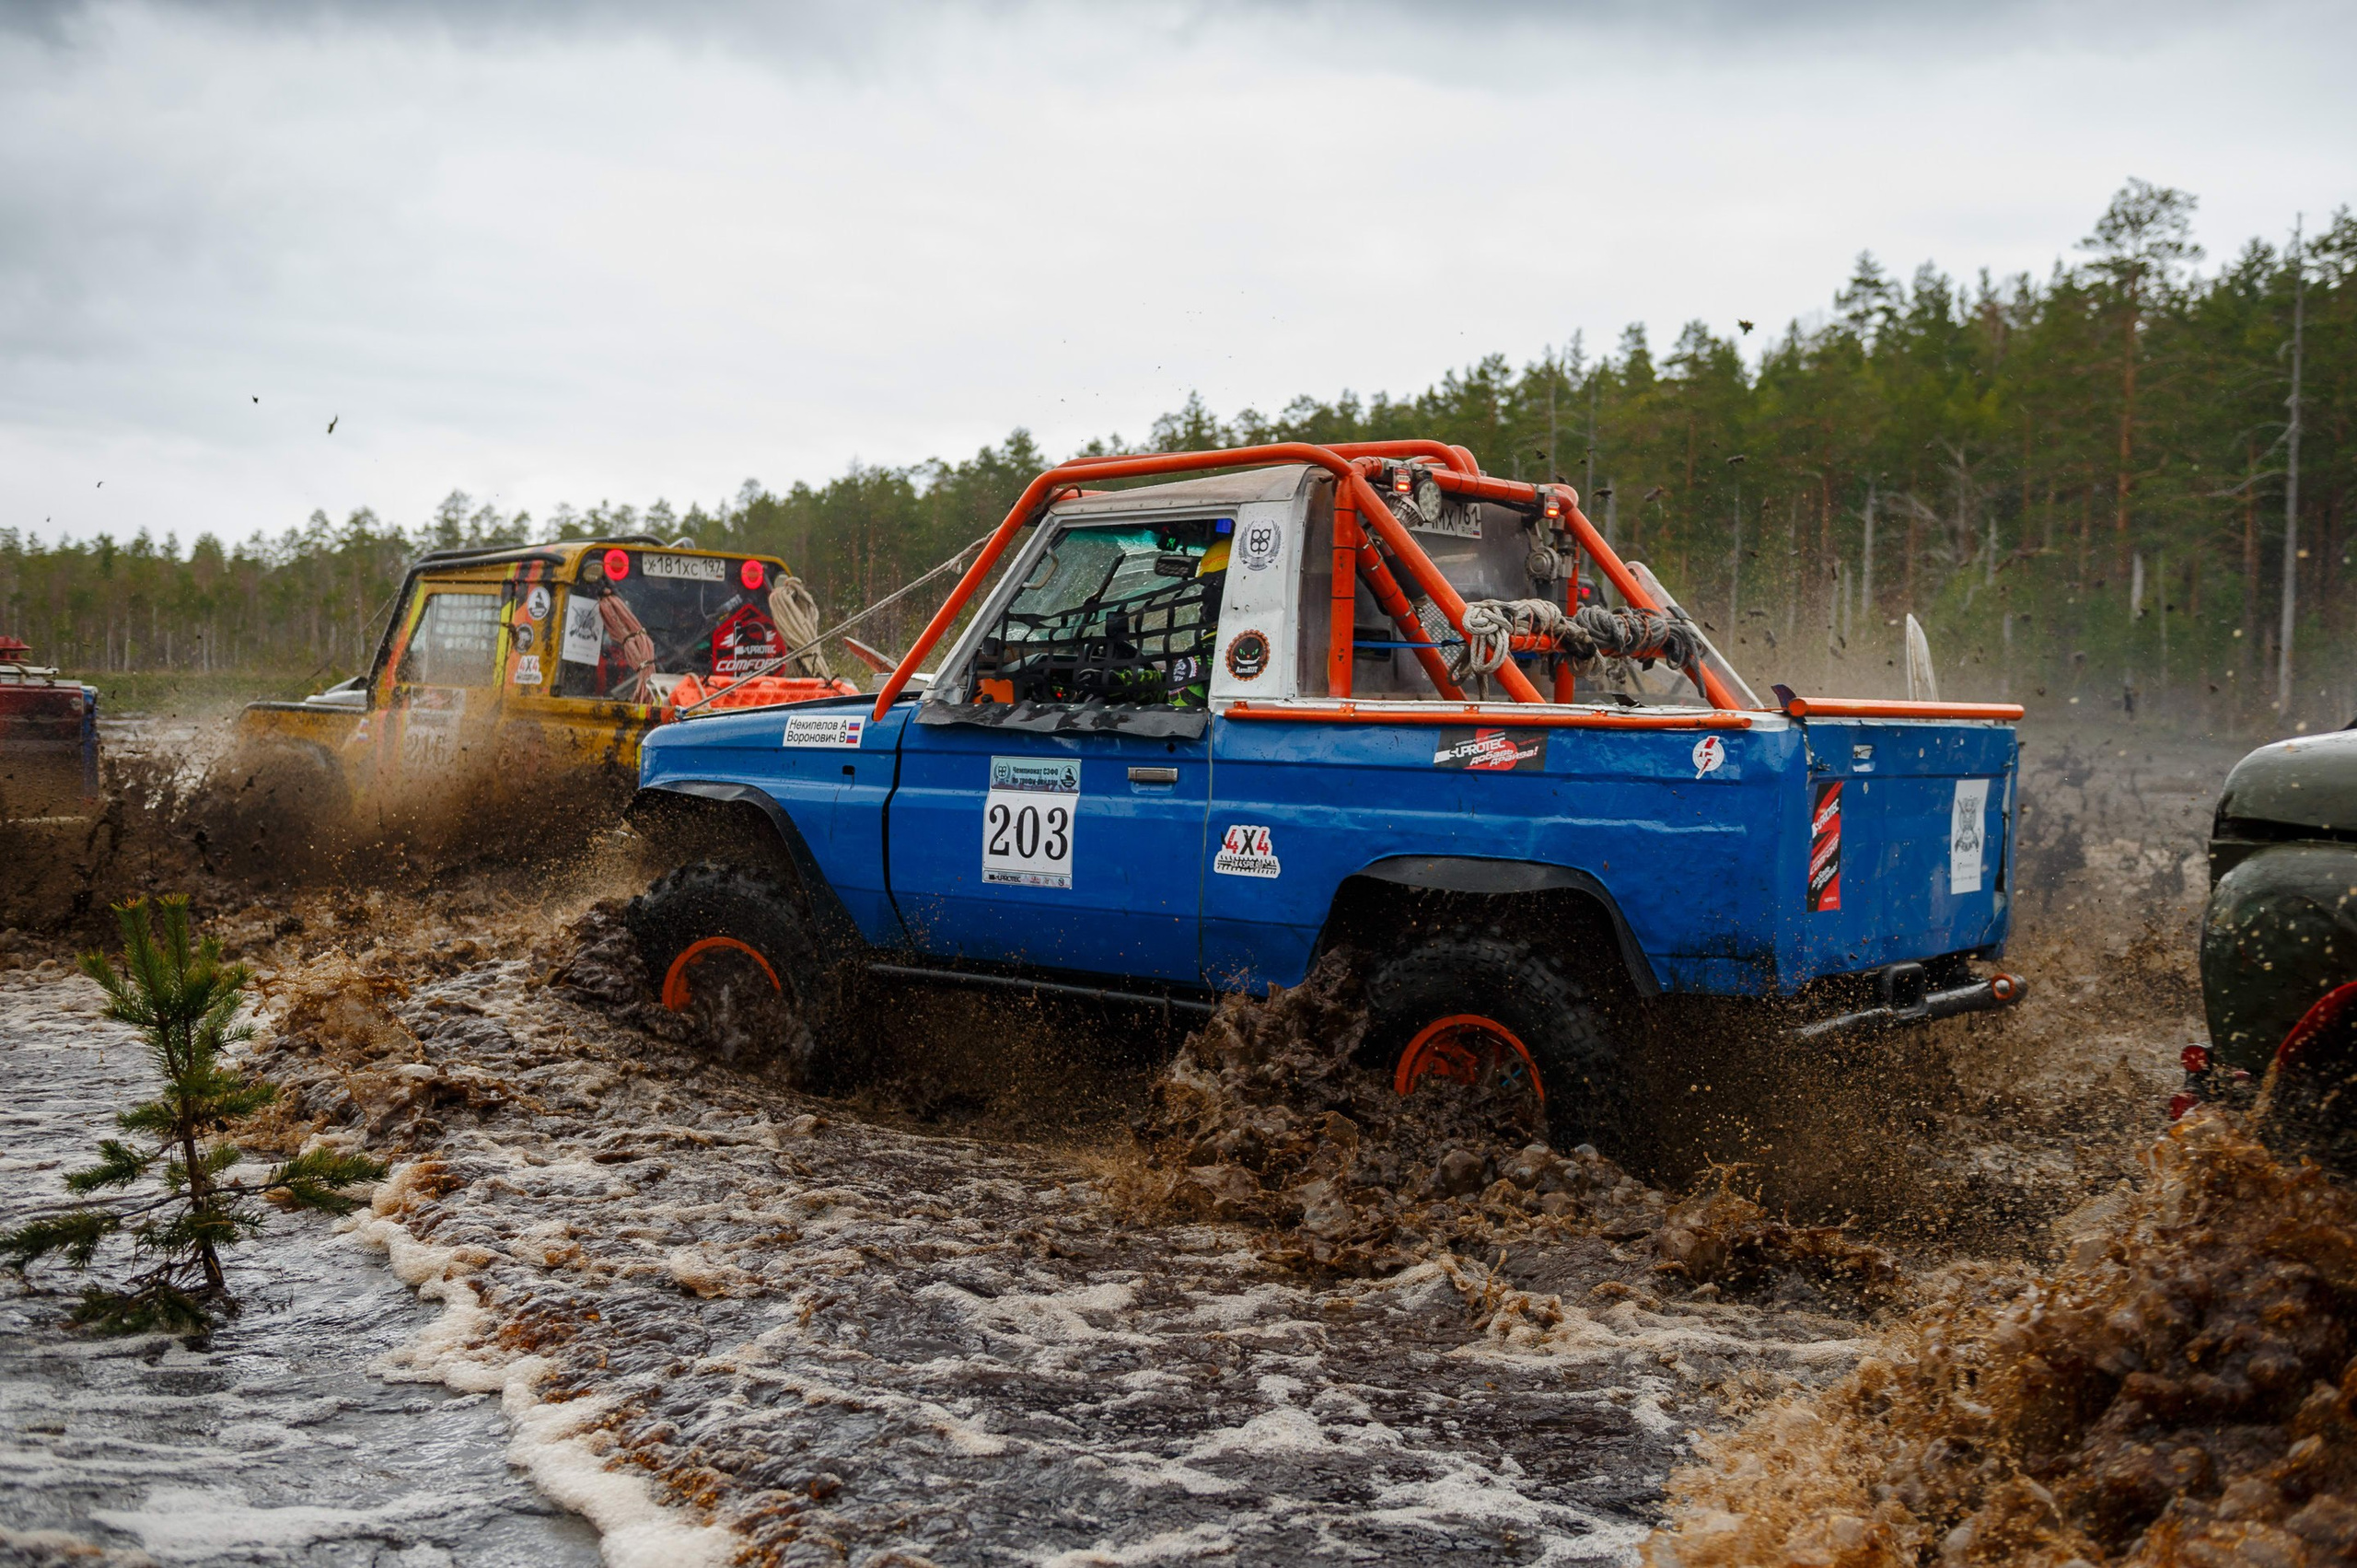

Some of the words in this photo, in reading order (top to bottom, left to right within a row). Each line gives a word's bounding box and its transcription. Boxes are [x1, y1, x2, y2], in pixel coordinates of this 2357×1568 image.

[1457, 503, 1479, 527] 761
[702, 559, 721, 574] 197
[789, 719, 838, 731] Некипелов
[840, 720, 847, 731] А
[787, 730, 837, 744] Воронович
[839, 731, 846, 742] В
[989, 804, 1068, 860] 203
[1225, 829, 1270, 855] 4X4
